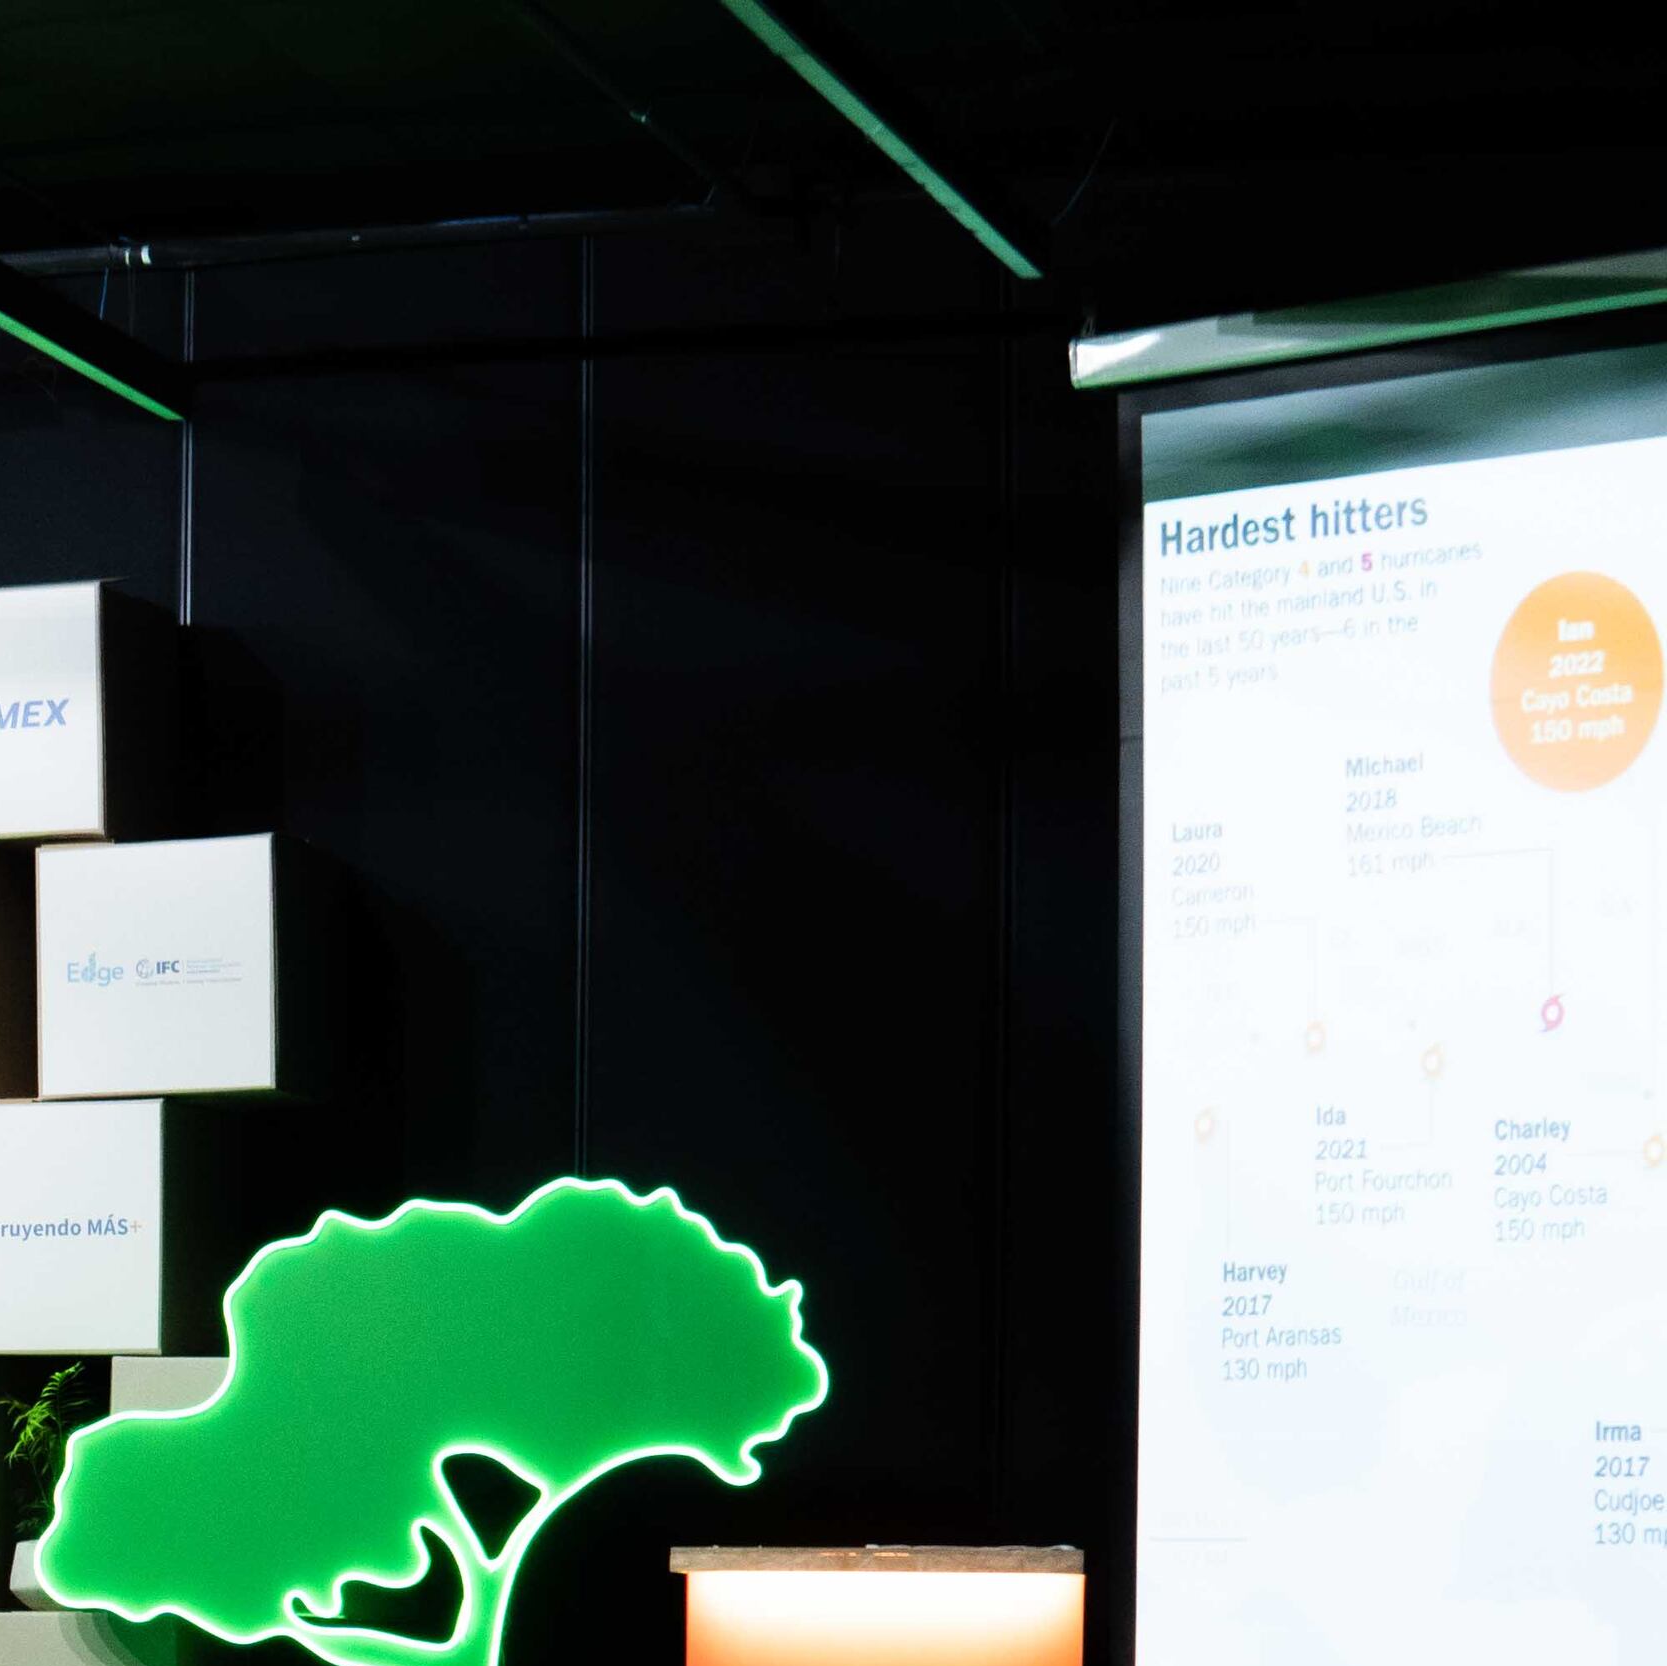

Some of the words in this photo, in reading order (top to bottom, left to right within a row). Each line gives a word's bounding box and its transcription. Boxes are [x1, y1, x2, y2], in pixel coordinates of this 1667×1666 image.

[1161, 507, 1295, 556] Hardest
[1310, 497, 1429, 539] hitters
[1208, 567, 1291, 592] Category
[1299, 560, 1310, 578] 4
[1317, 556, 1353, 577] and
[1360, 552, 1373, 572] 5
[1381, 542, 1483, 570] hurricanes
[1549, 650, 1606, 678] 2022
[1345, 754, 1424, 778] Michael
[1346, 789, 1397, 812] 2018
[1172, 821, 1223, 843] Laura
[1172, 852, 1220, 877] 2020
[156, 960, 180, 975] IFC
[1316, 1106, 1346, 1127] Ida
[1494, 1118, 1571, 1142] Charley
[1315, 1140, 1367, 1160] 2021
[1494, 1153, 1548, 1176] 2004
[1315, 1172, 1354, 1193] Port
[1362, 1170, 1452, 1192] Fourchon
[1493, 1187, 1542, 1211] Cayo
[1549, 1184, 1609, 1206] Costa
[1315, 1203, 1355, 1225] 150
[1362, 1202, 1405, 1226] mph
[1495, 1219, 1535, 1242] 150
[1542, 1219, 1586, 1241] mph
[1223, 1262, 1288, 1285] Harvey
[1222, 1295, 1272, 1317] 2017
[1222, 1328, 1260, 1349] Port
[1266, 1325, 1342, 1347] Aransas
[1222, 1360, 1260, 1381] 130
[1267, 1358, 1308, 1382] mph
[1596, 1420, 1642, 1442] Irma
[1595, 1456, 1650, 1478] 2017
[1595, 1488, 1665, 1516] Cudjoe
[1595, 1522, 1636, 1545] 130
